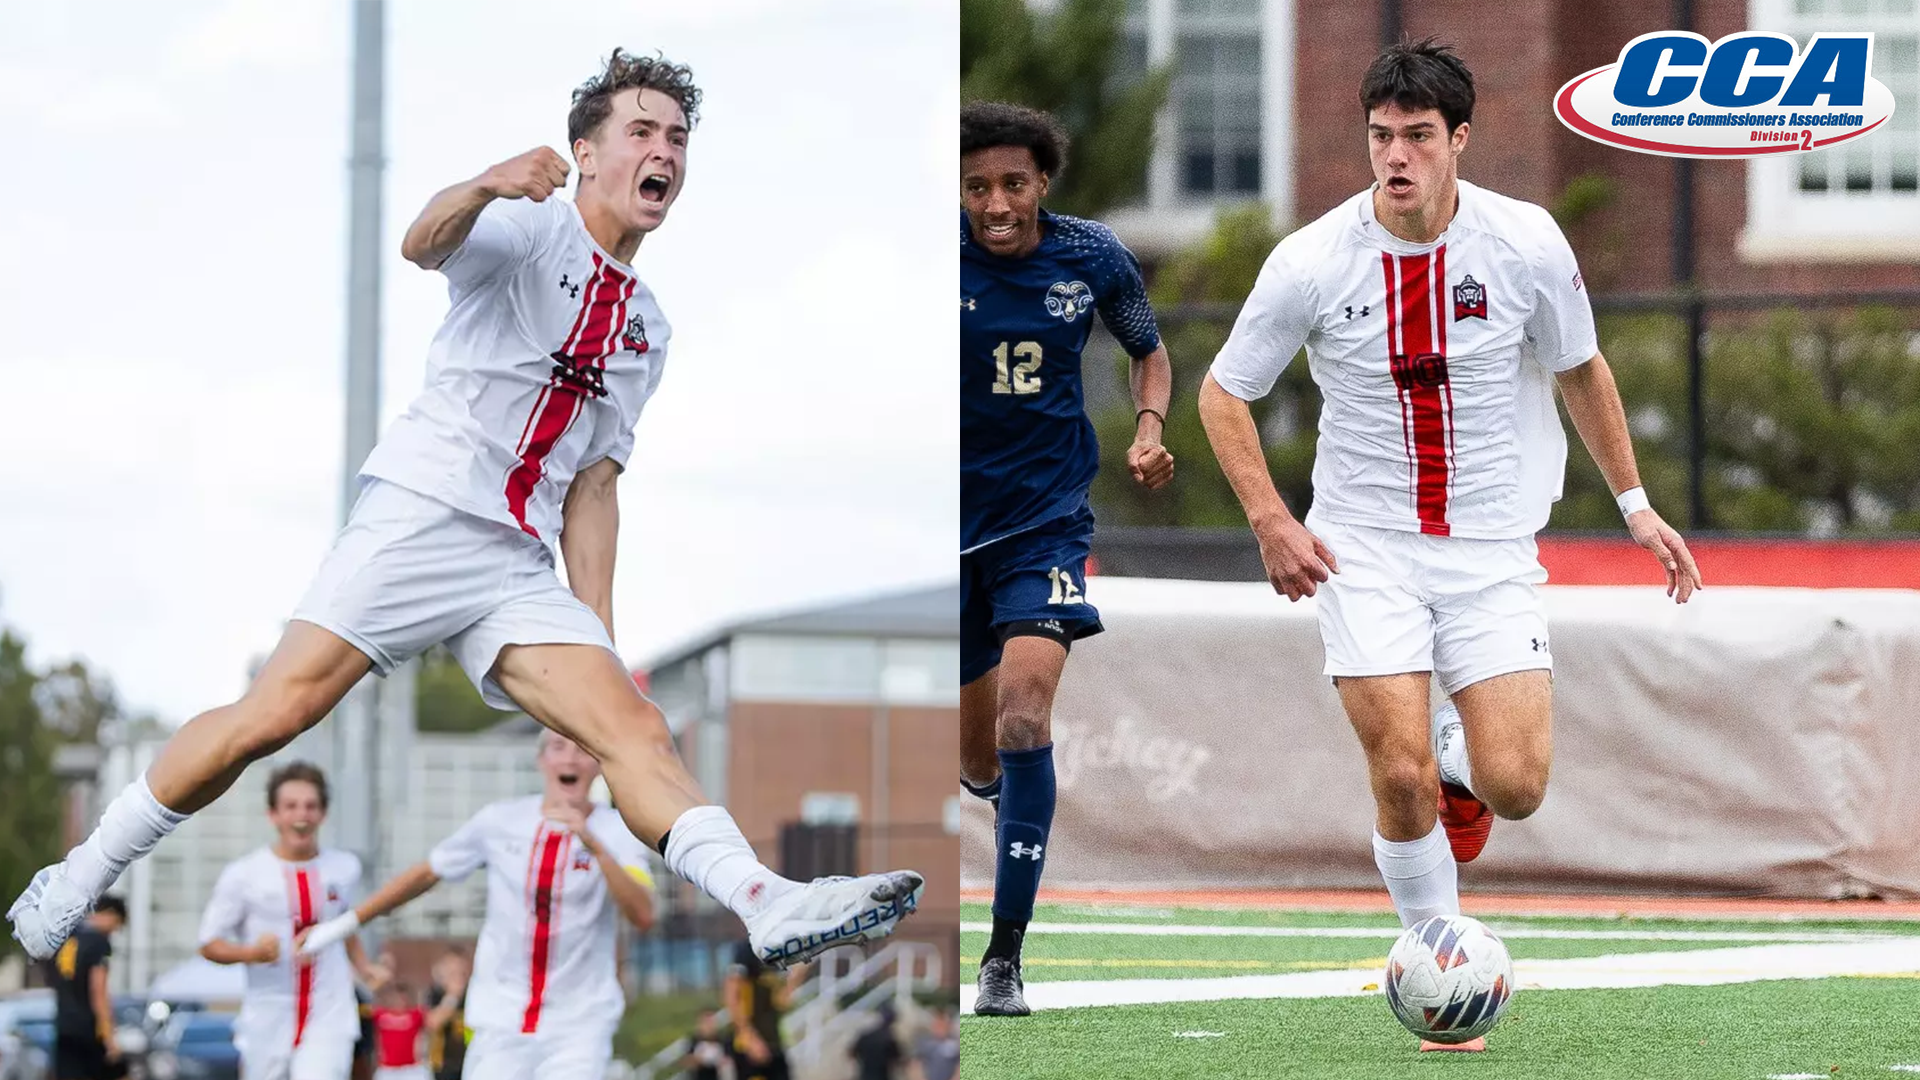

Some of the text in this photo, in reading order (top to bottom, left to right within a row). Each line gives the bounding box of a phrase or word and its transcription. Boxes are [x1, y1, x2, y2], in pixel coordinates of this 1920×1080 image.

[992, 341, 1043, 395] 12
[1393, 353, 1448, 390] 10
[764, 891, 917, 965] PREDATOR
